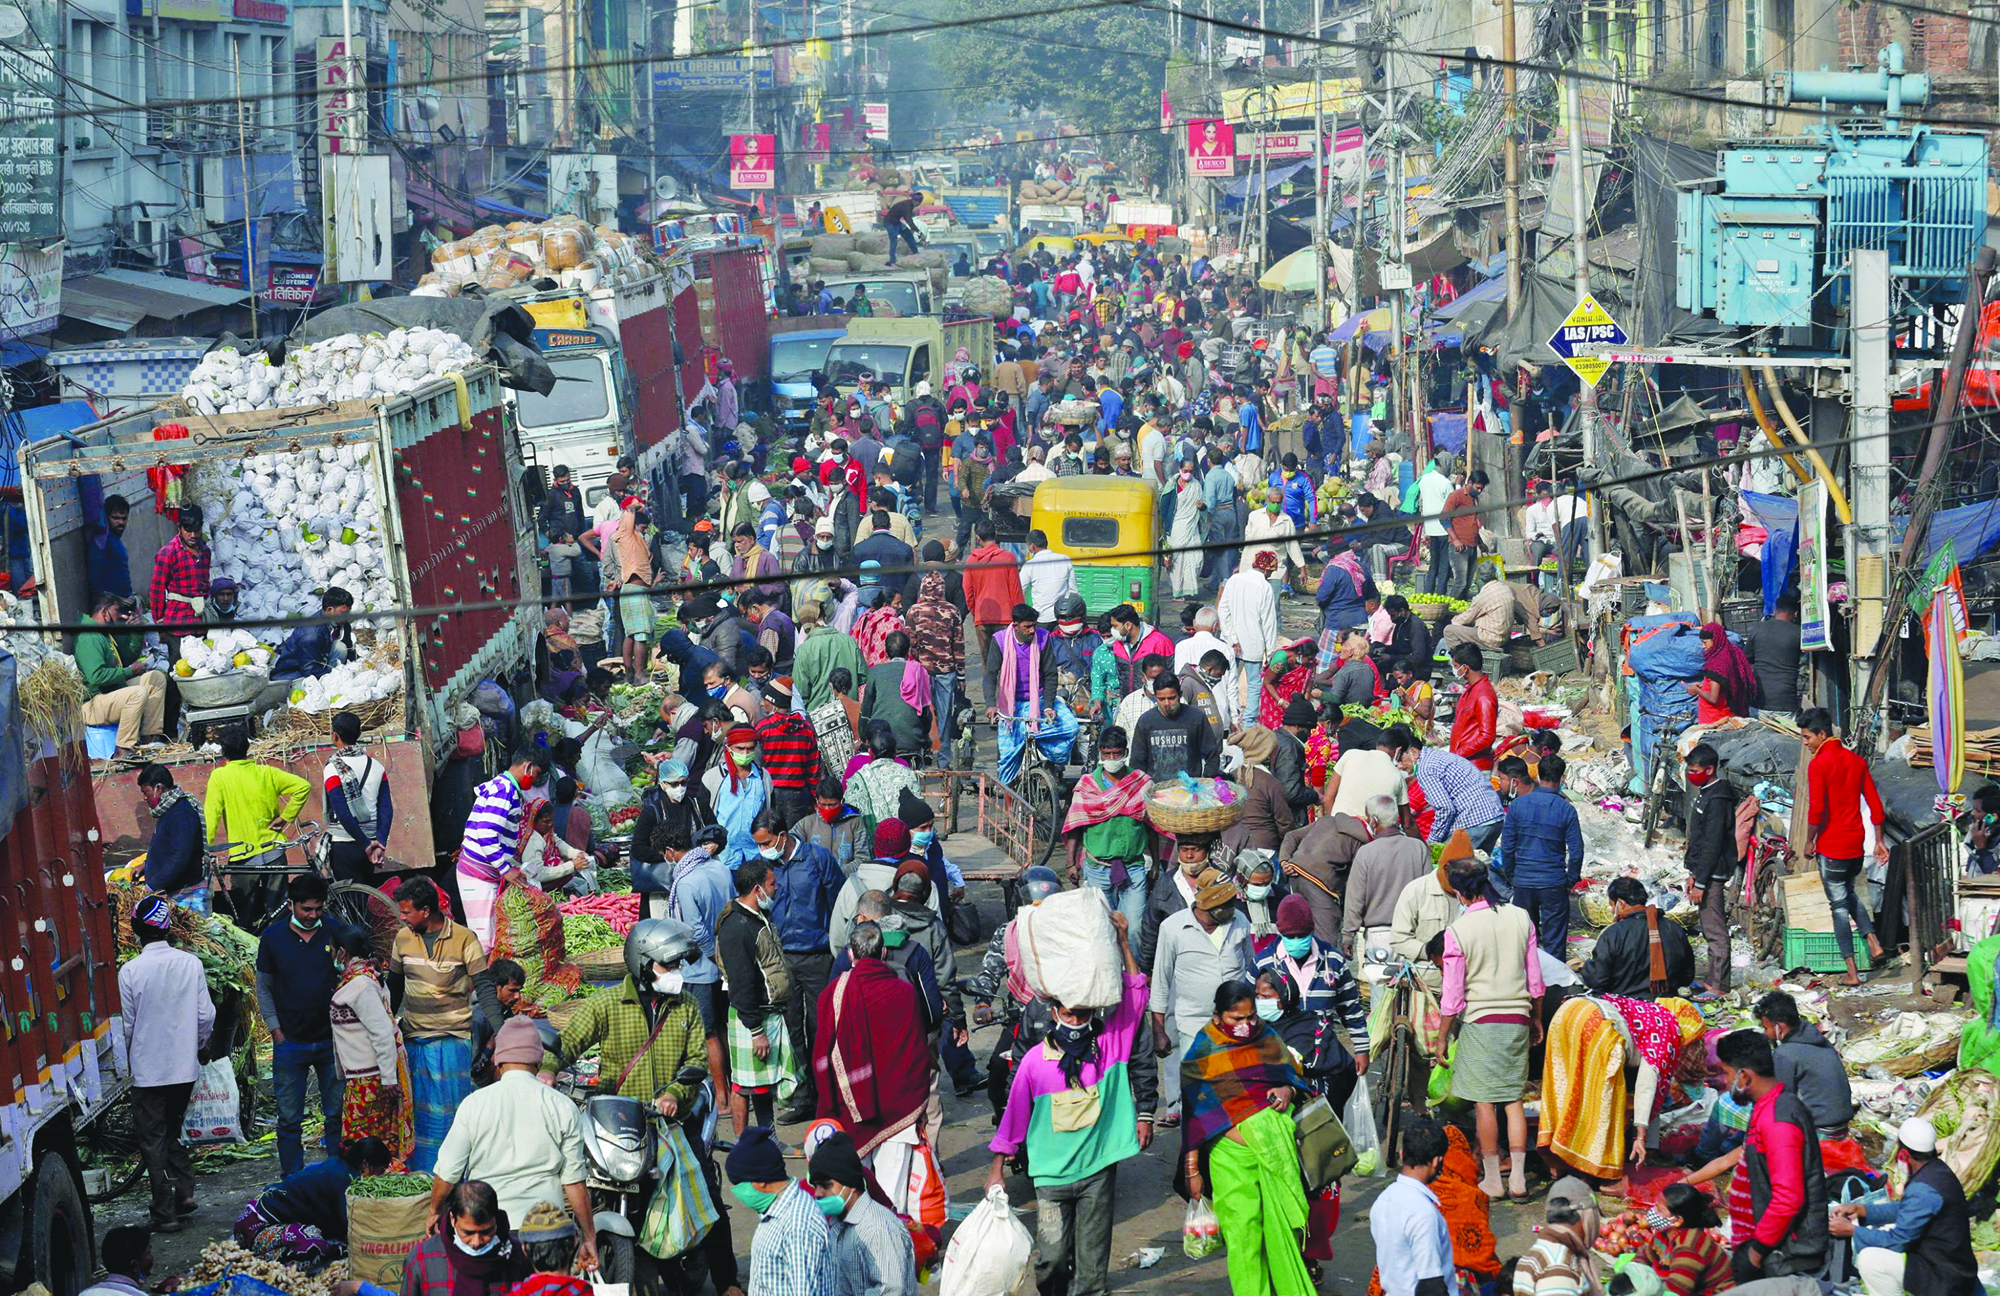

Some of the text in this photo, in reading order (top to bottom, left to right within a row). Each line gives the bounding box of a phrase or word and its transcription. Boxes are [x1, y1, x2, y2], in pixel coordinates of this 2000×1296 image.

[654, 60, 686, 73] HOTEL
[688, 60, 738, 73] ORIENTAL
[1335, 135, 1360, 146] utterfly
[549, 333, 597, 347] CARRIER
[1563, 325, 1615, 342] IAS/PSC
[1150, 735, 1188, 746] RUSHOUT
